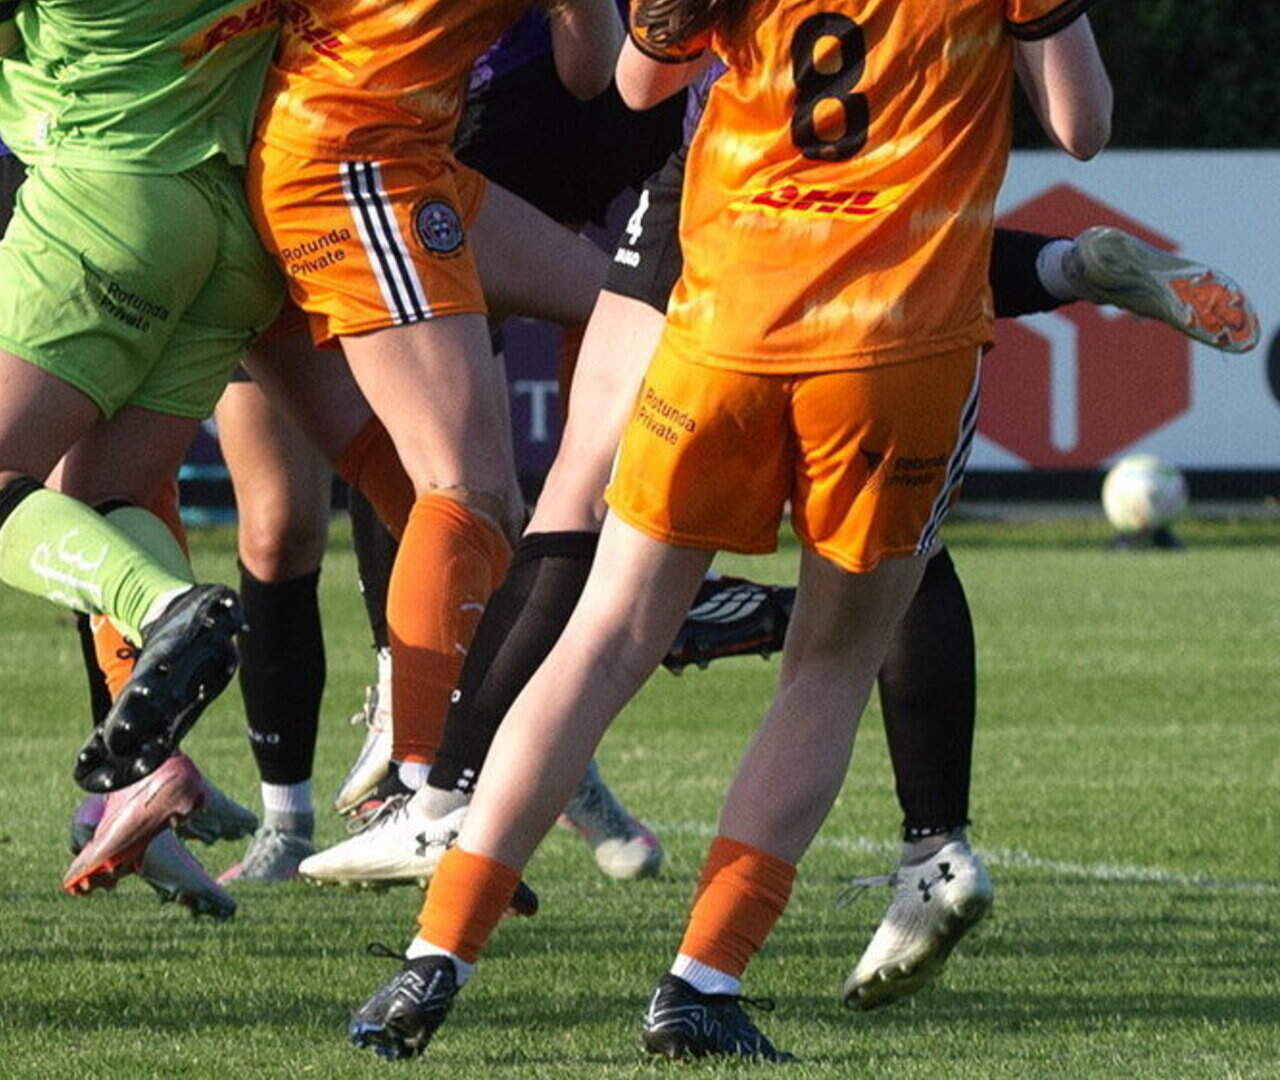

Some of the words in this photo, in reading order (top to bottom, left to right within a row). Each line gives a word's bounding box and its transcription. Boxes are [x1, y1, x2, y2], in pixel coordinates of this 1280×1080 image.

[791, 12, 869, 161] 8
[751, 185, 882, 215] DHL
[625, 189, 650, 246] 4
[281, 228, 351, 261] Rotunda
[291, 249, 346, 277] Private
